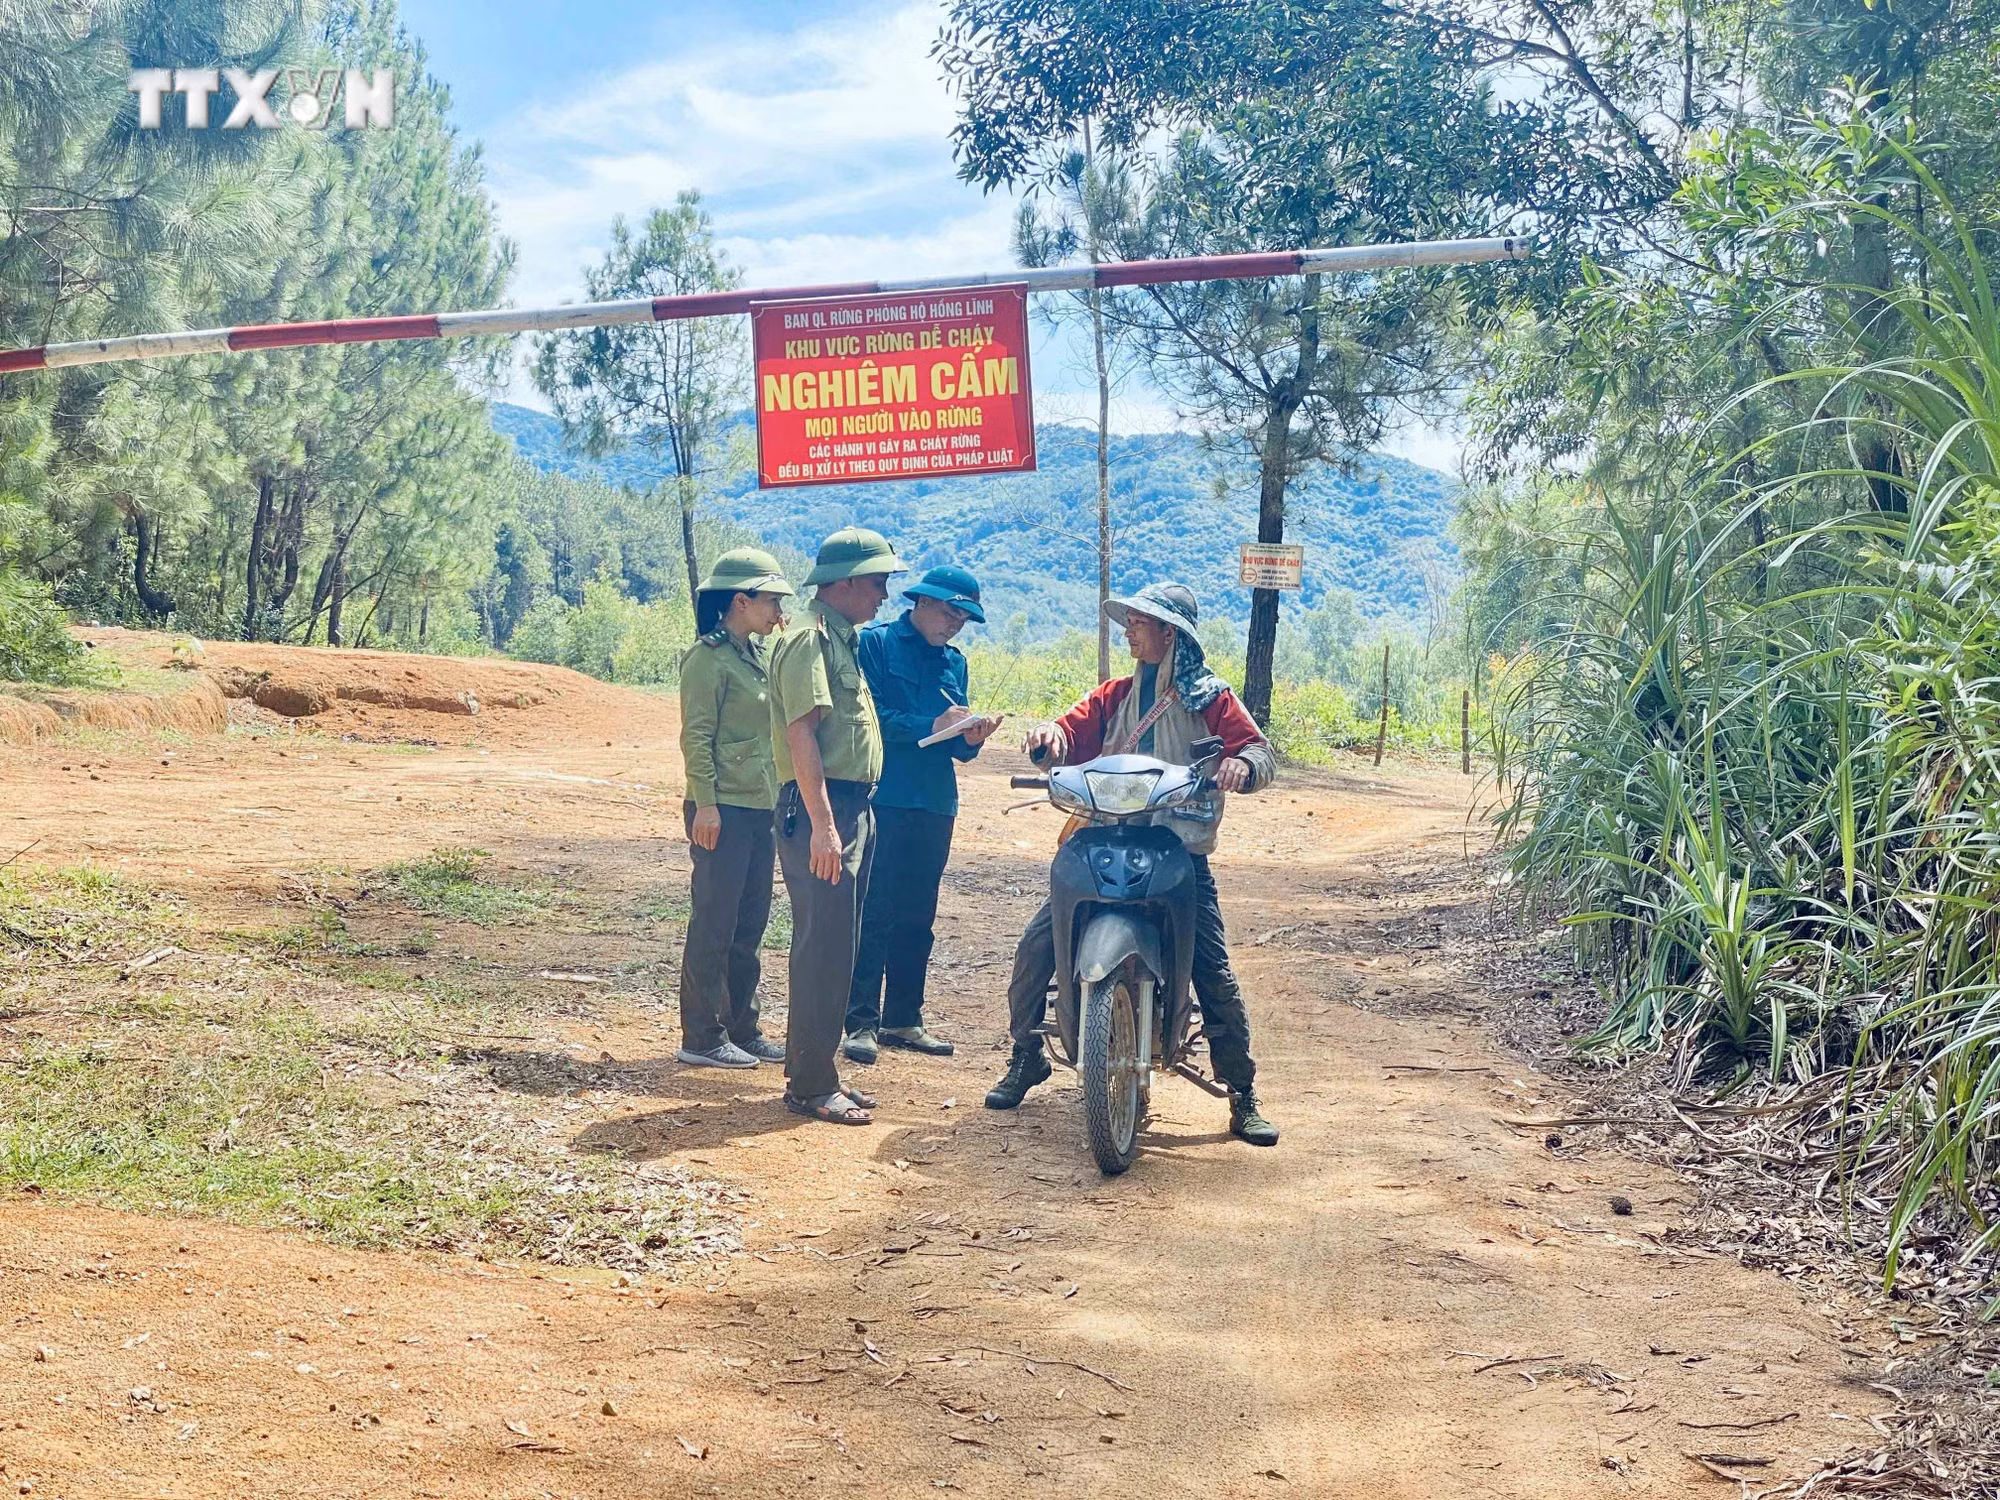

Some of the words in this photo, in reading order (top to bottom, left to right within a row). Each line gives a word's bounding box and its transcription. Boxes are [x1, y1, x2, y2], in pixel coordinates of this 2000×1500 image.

[784, 313, 809, 329] BAN
[812, 312, 826, 327] QL
[830, 307, 862, 326] RỪNG
[866, 304, 906, 323] PHÒNG
[910, 301, 926, 322] HỘ
[966, 298, 993, 316] LĨNH
[785, 338, 820, 359] KHU
[825, 334, 859, 360] VỰC
[866, 330, 914, 353] RỪNG
[920, 323, 942, 349] DỄ
[947, 323, 994, 348] CHÁY
[763, 359, 918, 412] NGHIÊM
[930, 347, 1019, 400] CẤM
[805, 417, 837, 440] MỌI
[843, 411, 893, 435] NGƯỜI
[898, 409, 931, 431] VÀO
[937, 405, 983, 429] RỪNG
[809, 442, 830, 458] CÁC
[834, 440, 862, 457] HÀNH
[866, 441, 876, 454] VI
[879, 438, 900, 453] GÂY
[903, 438, 917, 451] RA
[920, 435, 948, 450] CHÁY
[951, 432, 980, 448] RỪNG
[802, 464, 813, 478] BỊ
[816, 459, 833, 476] XỬ
[833, 459, 847, 474] LÝ
[849, 459, 875, 474] THEO
[878, 458, 899, 473] QUY
[902, 456, 928, 472] ĐỊNH
[931, 452, 953, 468] CỦA
[956, 450, 984, 466] PHÁP
[987, 449, 1014, 464] LUẬT
